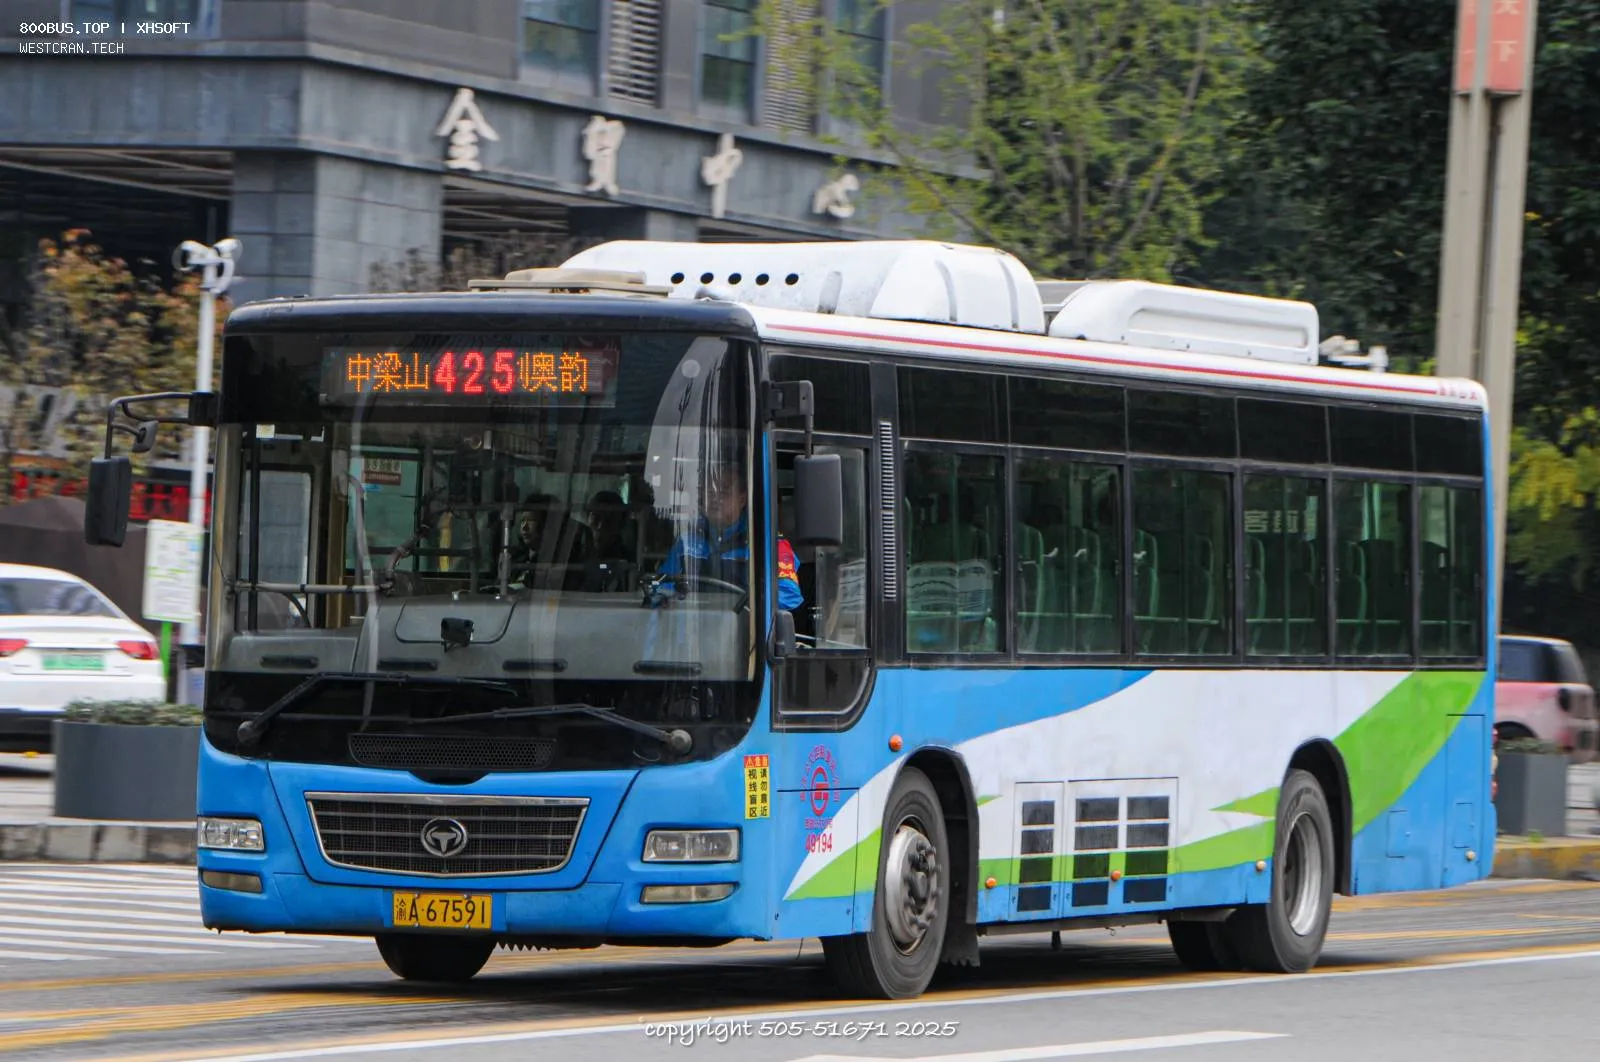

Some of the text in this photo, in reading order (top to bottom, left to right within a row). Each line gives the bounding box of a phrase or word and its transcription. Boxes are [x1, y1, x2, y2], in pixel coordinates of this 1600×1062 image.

[347, 352, 430, 393] 中梁山
[434, 352, 515, 393] 425
[805, 833, 833, 854] 49194
